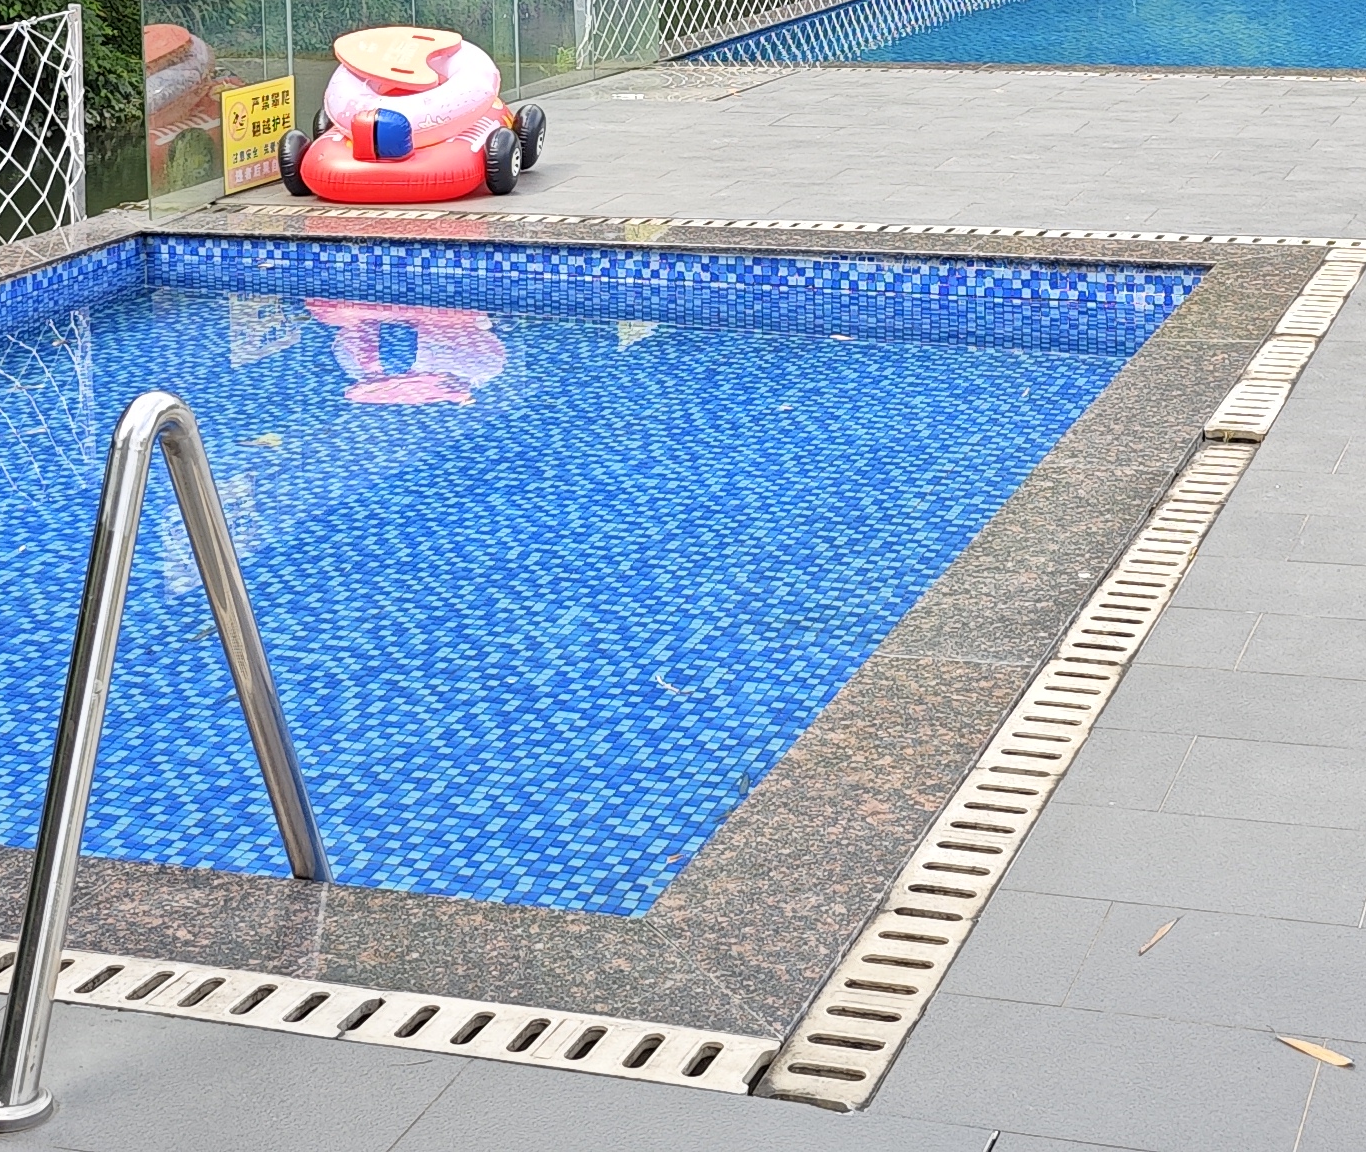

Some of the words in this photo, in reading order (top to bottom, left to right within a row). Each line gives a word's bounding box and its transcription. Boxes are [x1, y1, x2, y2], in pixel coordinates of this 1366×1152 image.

[250, 89, 290, 114] 严禁攀爬
[252, 112, 292, 138] 翻越护栏
[232, 146, 259, 165] 注意安全
[235, 158, 279, 184] 违者后果自
